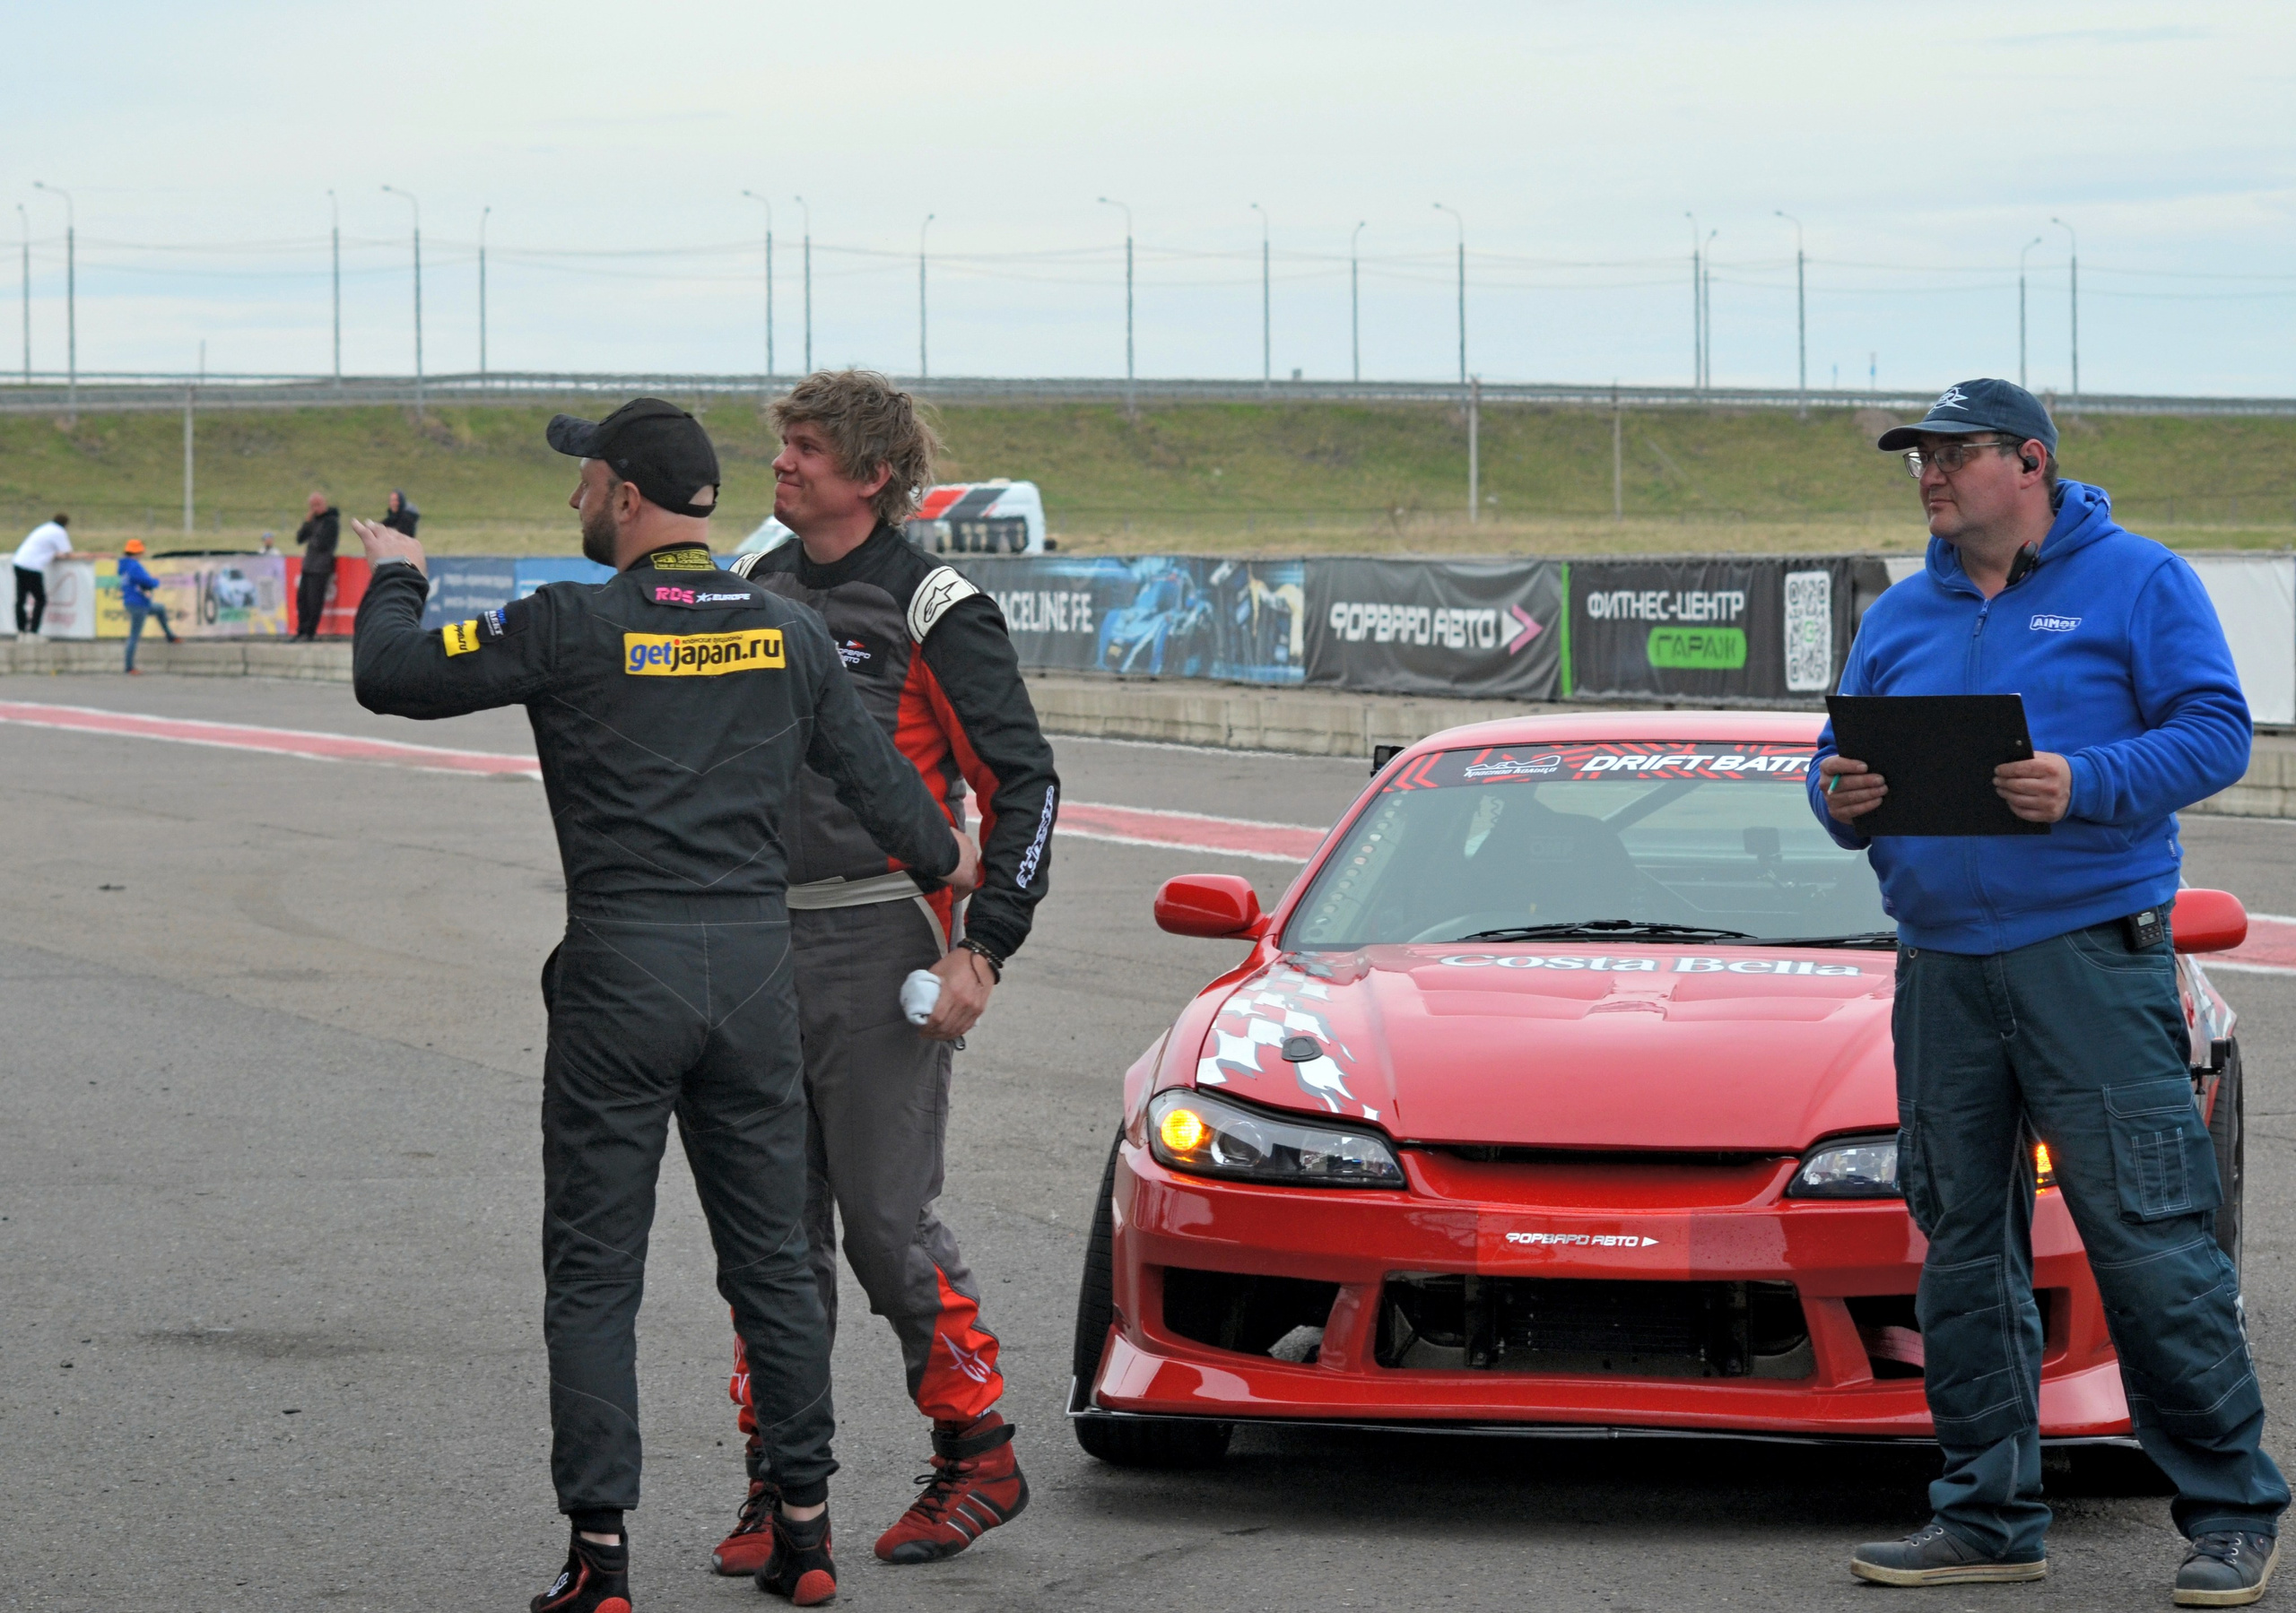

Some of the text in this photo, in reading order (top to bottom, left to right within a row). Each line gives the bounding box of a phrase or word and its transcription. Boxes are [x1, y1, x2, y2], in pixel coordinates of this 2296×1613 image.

[712, 594, 752, 602] EUROPE
[1587, 591, 1744, 620] ФИТНЕС-ЦЕНТР
[987, 591, 1070, 632] ACELINE
[1431, 607, 1496, 649] АВТО
[629, 637, 780, 672] getjapan.ru
[838, 647, 871, 659] ОРВАРД
[1656, 635, 1736, 659] ГАРАЖ
[1579, 755, 1811, 772] DRIFT BATT
[1439, 953, 1861, 977] Costa Bella
[1591, 1235, 1639, 1247] АВТО
